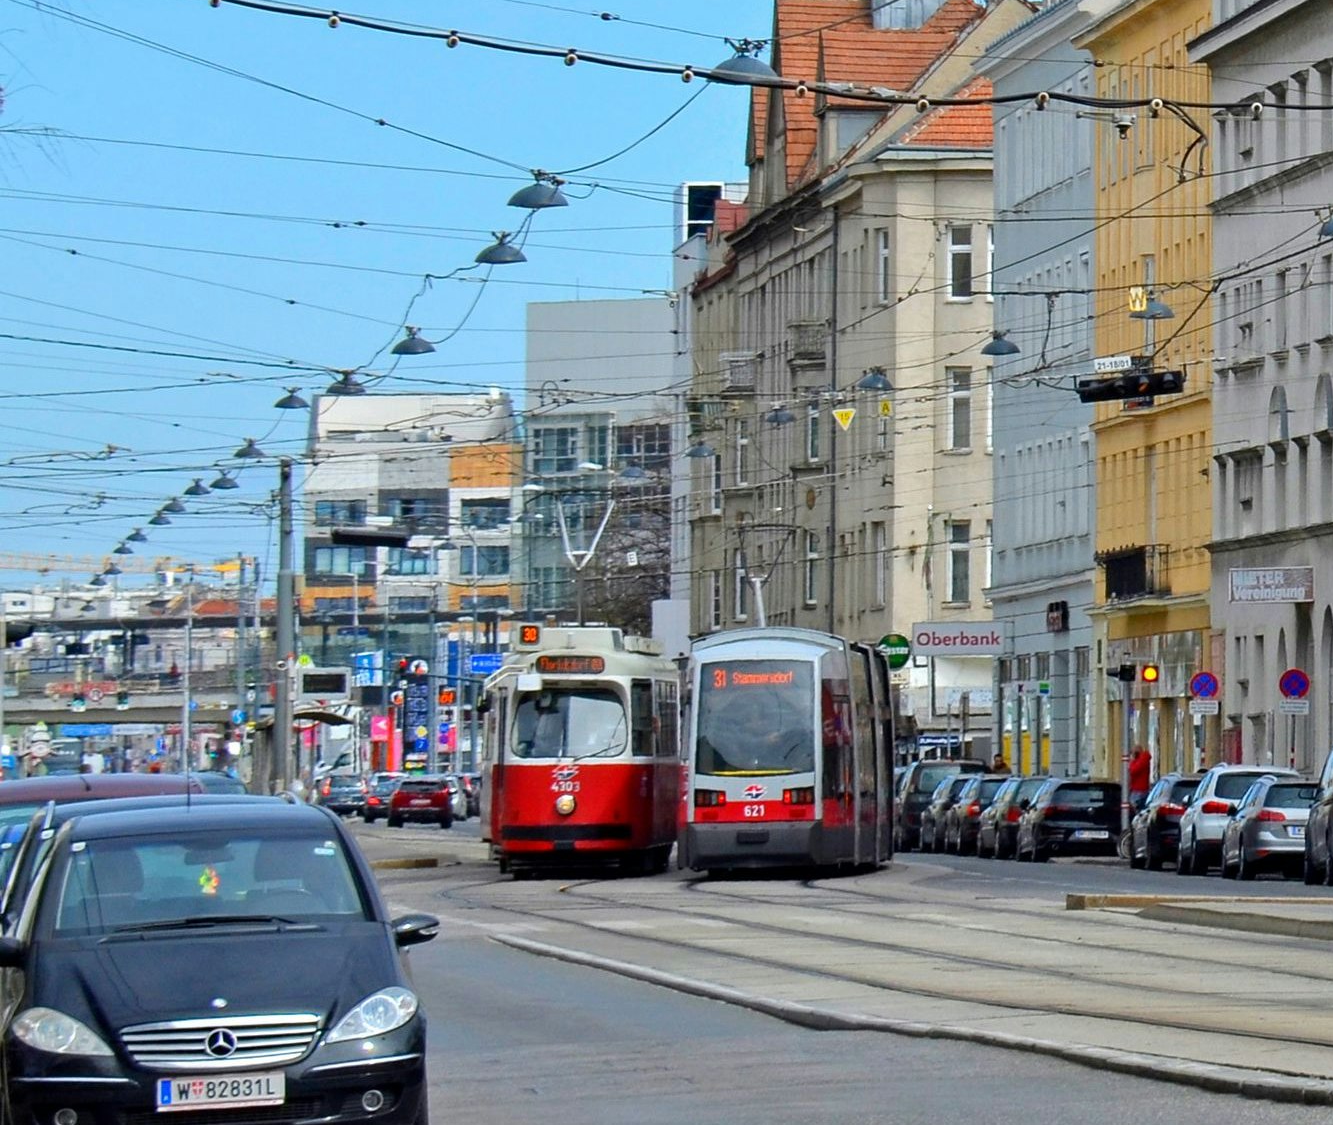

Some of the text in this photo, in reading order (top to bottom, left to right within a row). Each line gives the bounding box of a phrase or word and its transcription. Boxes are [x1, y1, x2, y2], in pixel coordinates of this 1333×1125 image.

[523, 627, 537, 642] 30
[916, 630, 1001, 647] Oberbank
[713, 669, 727, 690] 31
[551, 781, 581, 793] 4303
[743, 804, 765, 817] 621
[177, 1082, 191, 1100] W
